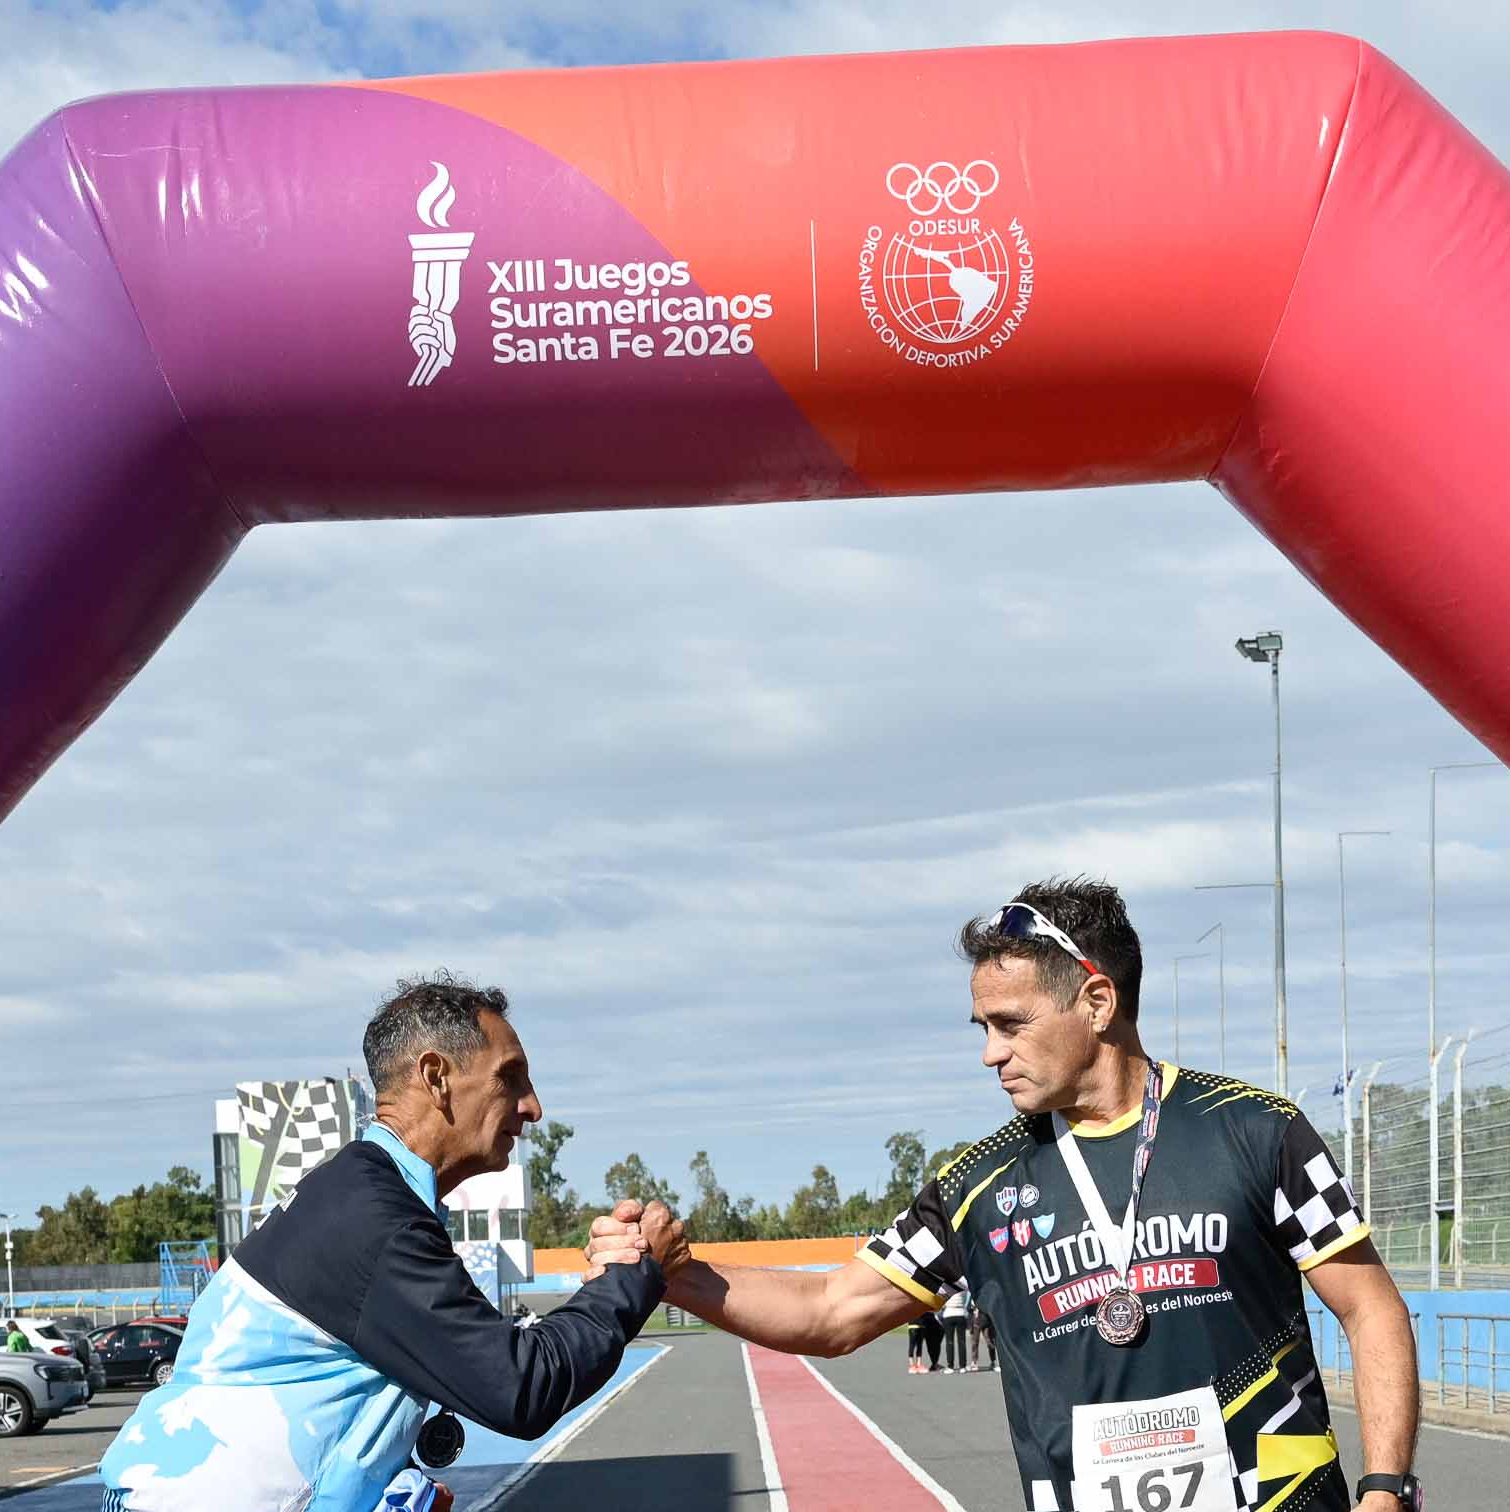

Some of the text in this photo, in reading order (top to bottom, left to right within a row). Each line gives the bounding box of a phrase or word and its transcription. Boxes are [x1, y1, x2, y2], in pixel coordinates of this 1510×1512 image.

[908, 218, 982, 237] ODESUR
[486, 258, 691, 296] XIII Juegos
[858, 217, 1034, 368] ORGANIZACION DEPORTIVA SURAMERICANA
[489, 288, 774, 329] Suramericanos
[492, 323, 755, 364] Santa Fe 2026
[1022, 1213, 1228, 1296] AUTÓROMO
[1142, 1262, 1196, 1289] RACE
[1161, 1296, 1182, 1312] del
[1032, 1330, 1045, 1343] La
[1093, 1406, 1201, 1442] AUTÓDROMO
[1109, 1431, 1185, 1452] RUNNING RACE
